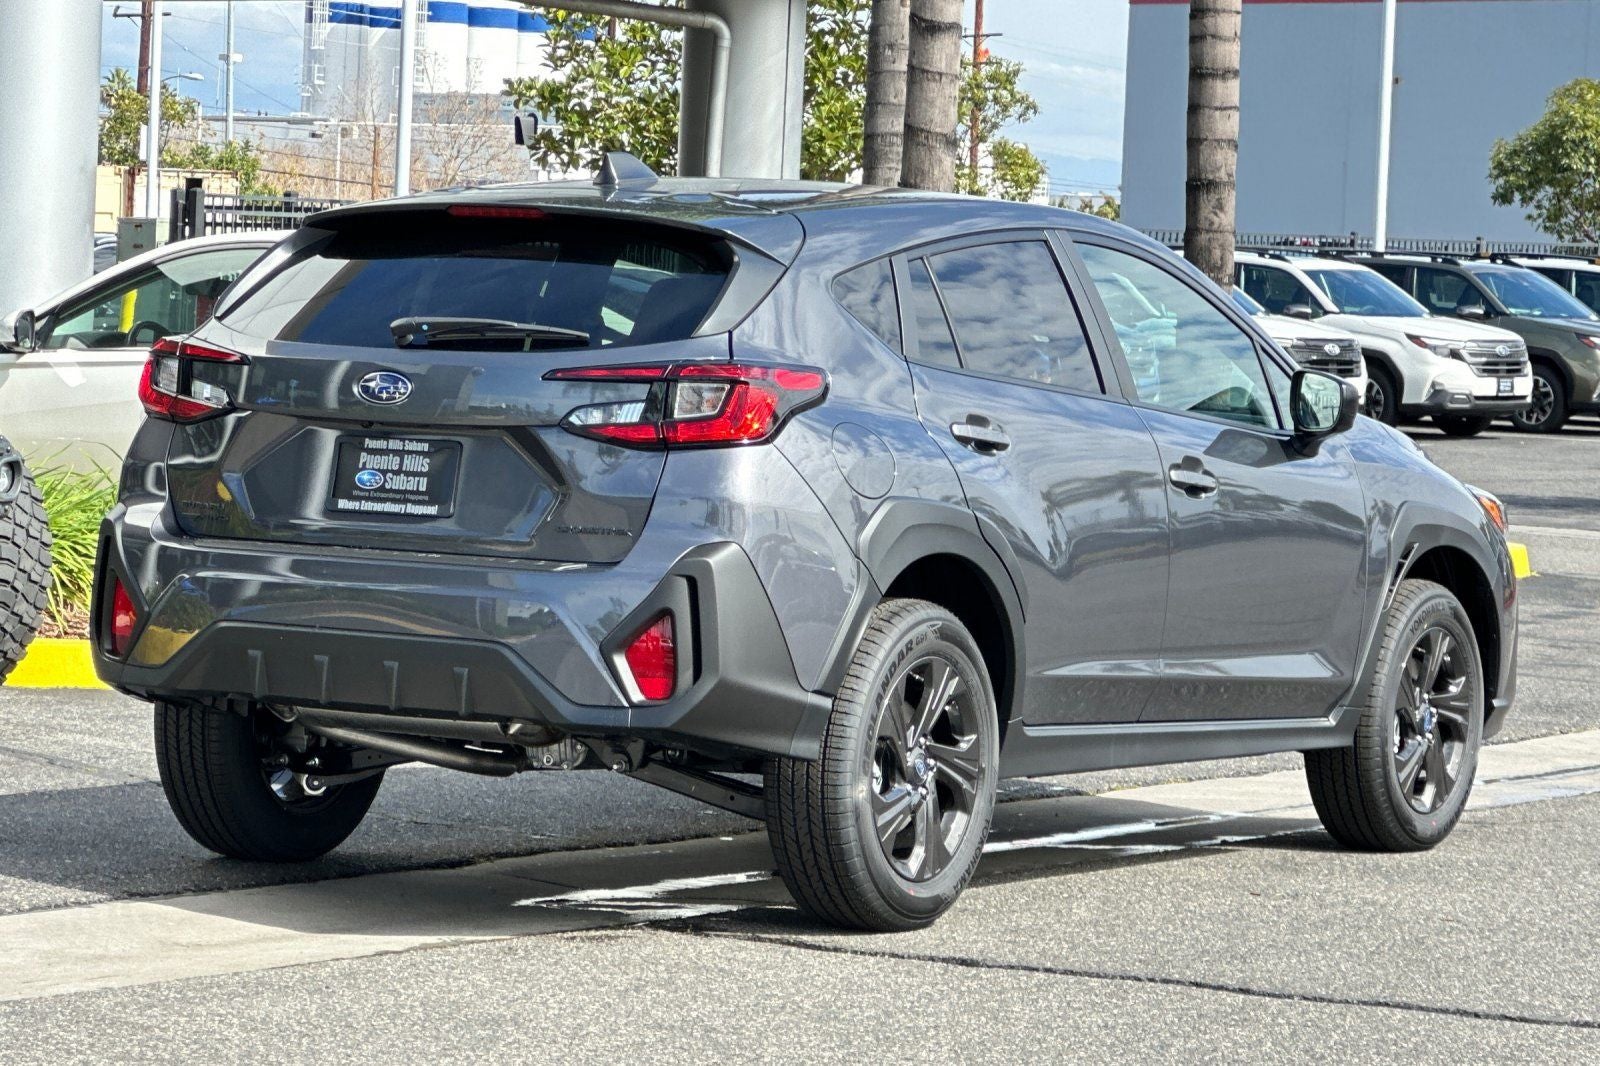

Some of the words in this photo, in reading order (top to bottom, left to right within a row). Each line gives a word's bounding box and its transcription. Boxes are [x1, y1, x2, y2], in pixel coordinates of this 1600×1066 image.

[365, 438, 387, 449] Puente
[388, 439, 403, 450] Hills
[404, 440, 429, 452] Subaru
[359, 452, 400, 470] Puente
[402, 454, 430, 472] Hills
[385, 473, 428, 491] Subaru
[338, 498, 359, 510] Where
[360, 501, 406, 514] Extraordinary
[406, 503, 438, 515] Happens!
